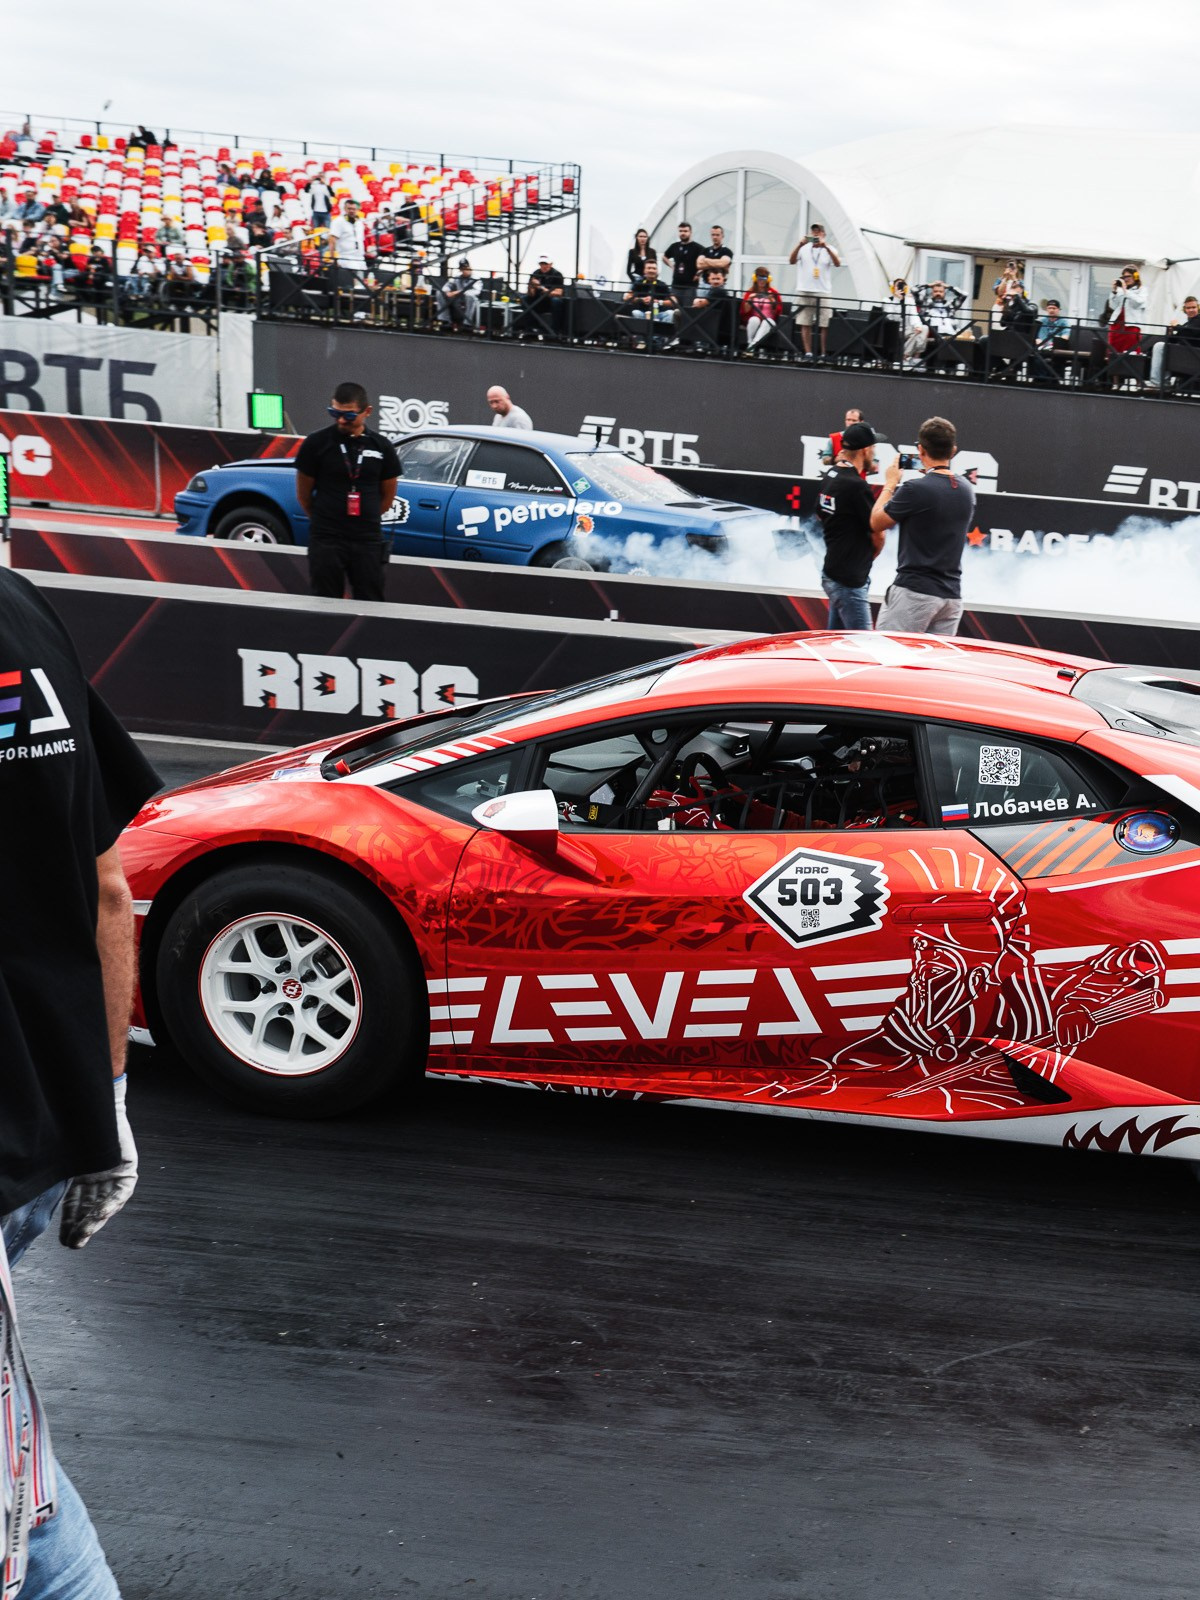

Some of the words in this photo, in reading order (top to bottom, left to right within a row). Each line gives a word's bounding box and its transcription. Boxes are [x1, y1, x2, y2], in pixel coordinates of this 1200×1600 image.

[0, 349, 162, 422] ВТБ
[618, 427, 701, 468] ВТБ
[481, 475, 498, 486] ВТБ
[493, 498, 623, 532] petrolero
[237, 648, 479, 719] RDRC
[973, 798, 1069, 818] Лобачев
[1075, 793, 1097, 809] А.
[795, 866, 829, 875] RDRC
[777, 877, 843, 907] 503
